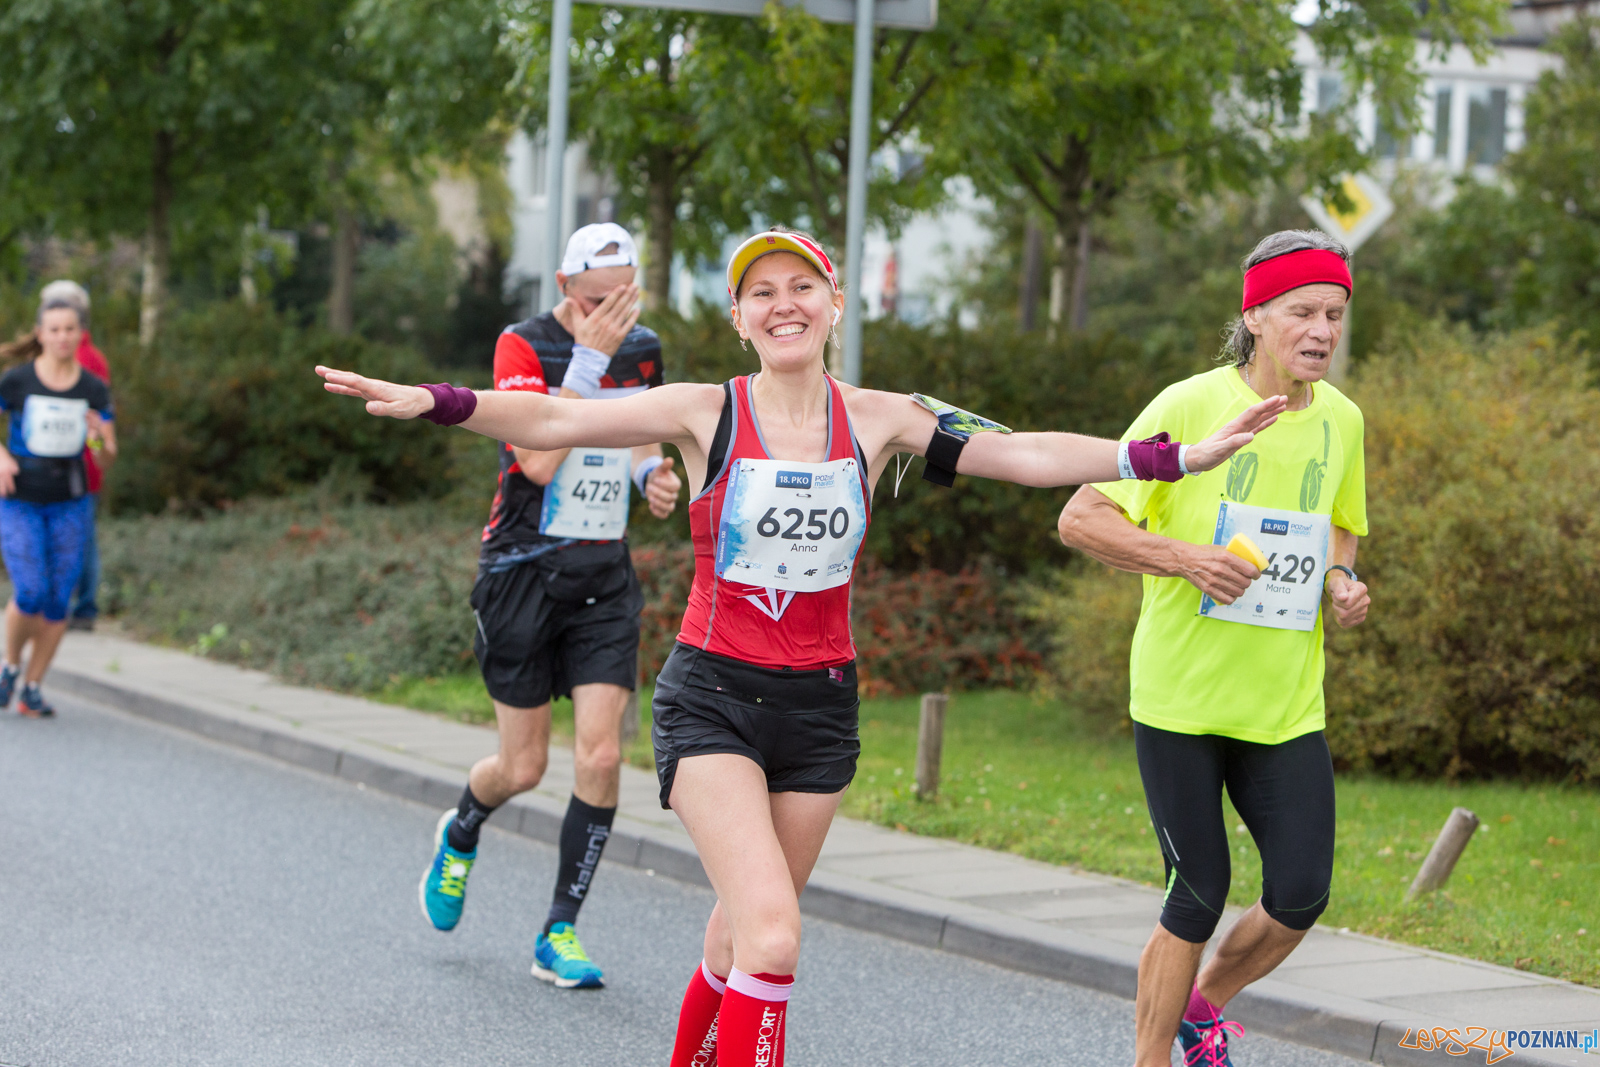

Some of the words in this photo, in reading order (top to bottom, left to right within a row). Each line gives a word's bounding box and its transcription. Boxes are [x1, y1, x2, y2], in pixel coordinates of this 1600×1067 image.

[779, 475, 790, 484] 18.
[791, 476, 809, 485] PKO
[571, 480, 621, 502] 4729
[756, 506, 849, 541] 6250
[1264, 522, 1273, 530] 18.
[1273, 523, 1287, 532] PKO
[790, 543, 818, 552] Anna
[803, 568, 818, 577] 4F
[1261, 551, 1316, 584] 429
[1266, 583, 1291, 595] Marta
[568, 823, 609, 900] Kalenji
